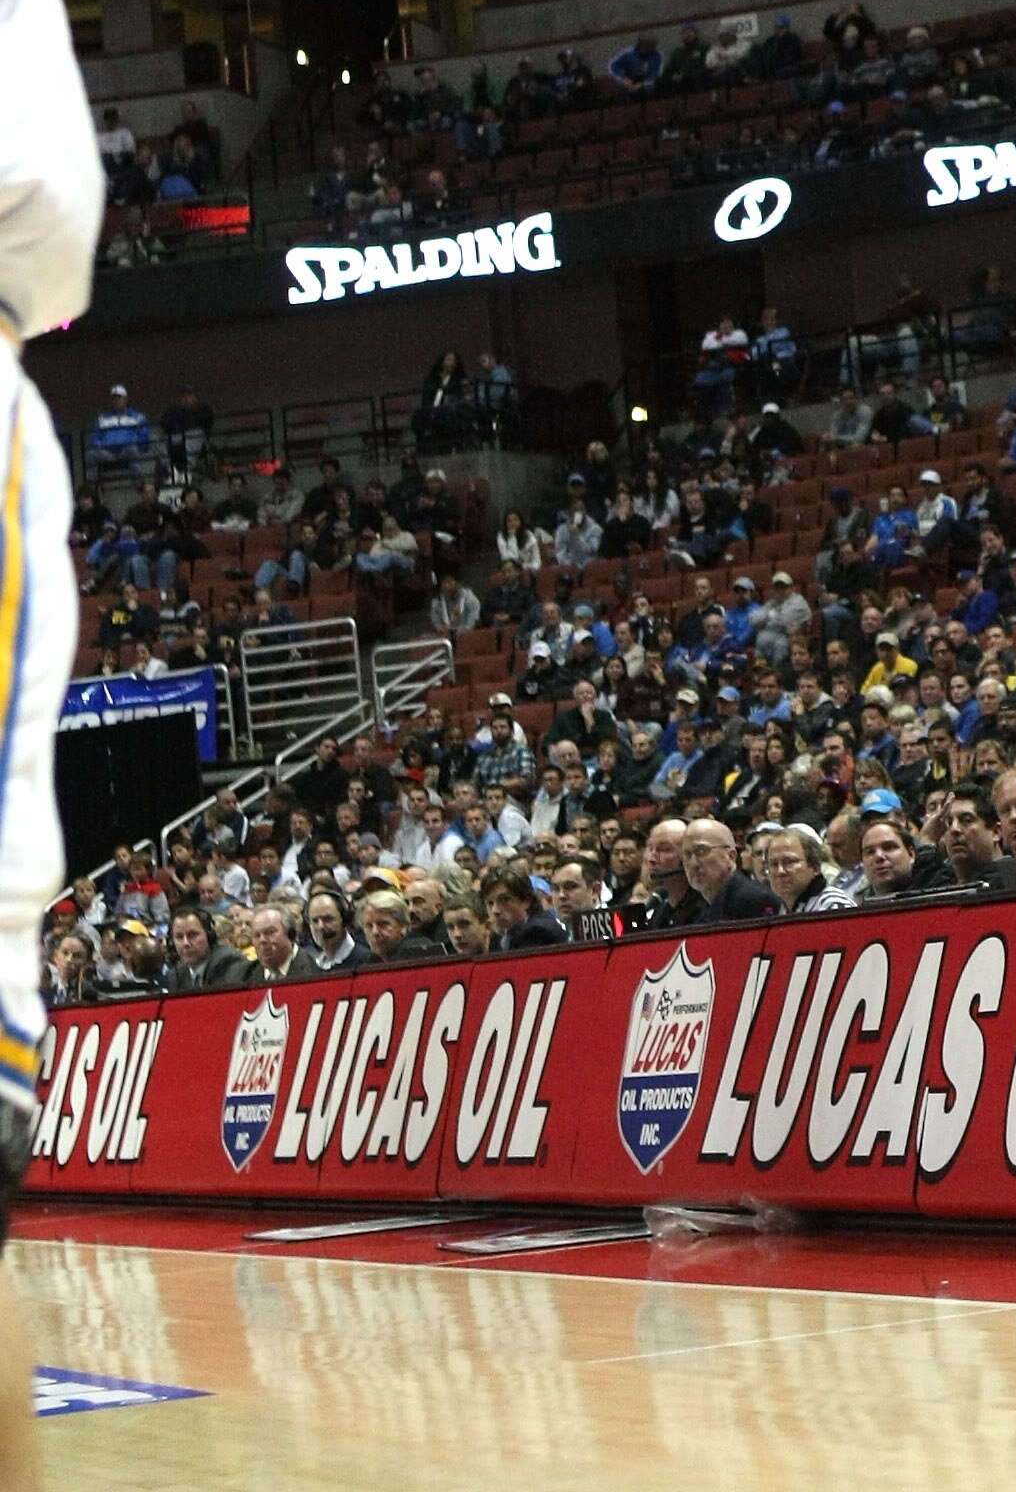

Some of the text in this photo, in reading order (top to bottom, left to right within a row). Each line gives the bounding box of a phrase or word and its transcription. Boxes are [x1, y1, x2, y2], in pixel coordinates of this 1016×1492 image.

[286, 212, 557, 305] SPALDING
[87, 1019, 164, 1166] OIL
[273, 979, 568, 1166] LUCAS OIL
[621, 1086, 694, 1112] OIL PRODUCTS
[631, 1020, 703, 1073] LUCAS
[701, 935, 1006, 1175] LUCAS
